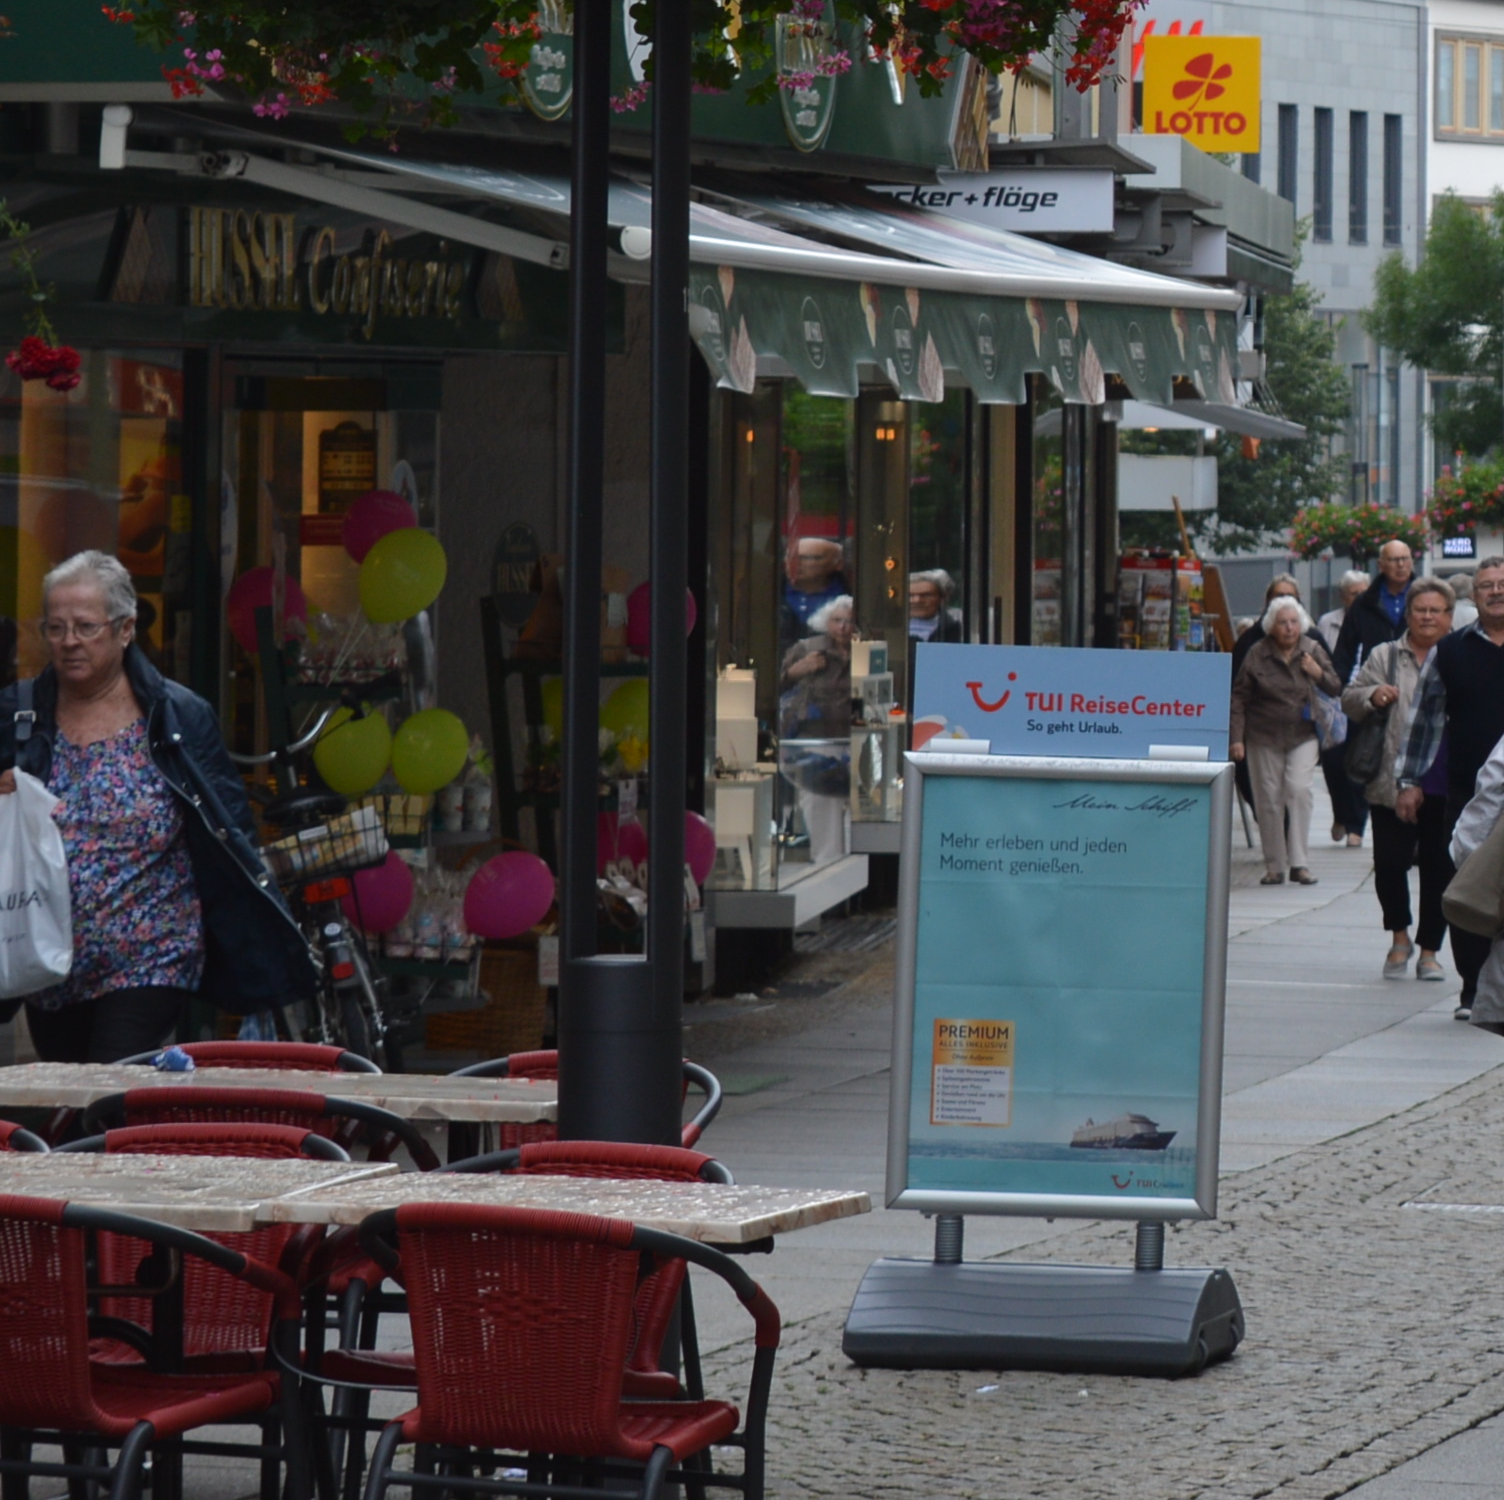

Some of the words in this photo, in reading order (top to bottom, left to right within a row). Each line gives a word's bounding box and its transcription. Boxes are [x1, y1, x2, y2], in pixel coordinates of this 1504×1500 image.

[1155, 110, 1247, 136] LOTTO
[877, 185, 963, 207] cker
[982, 186, 1059, 213] flöge
[1024, 691, 1063, 712] TUI
[1070, 693, 1206, 717] ReiseCenter
[1026, 719, 1044, 732] So
[1046, 720, 1075, 735] geht
[1078, 721, 1123, 735] Urlaub.
[939, 832, 981, 850] Mehr
[985, 833, 1044, 851] erleben
[1049, 836, 1079, 852] und
[1083, 837, 1128, 857] jeden
[939, 854, 1004, 872] Moment
[1009, 857, 1084, 876] genießen.
[938, 1024, 1009, 1040] PREMIUM
[938, 1040, 964, 1048] ALLES
[966, 1041, 1008, 1049] INKLUSIVE
